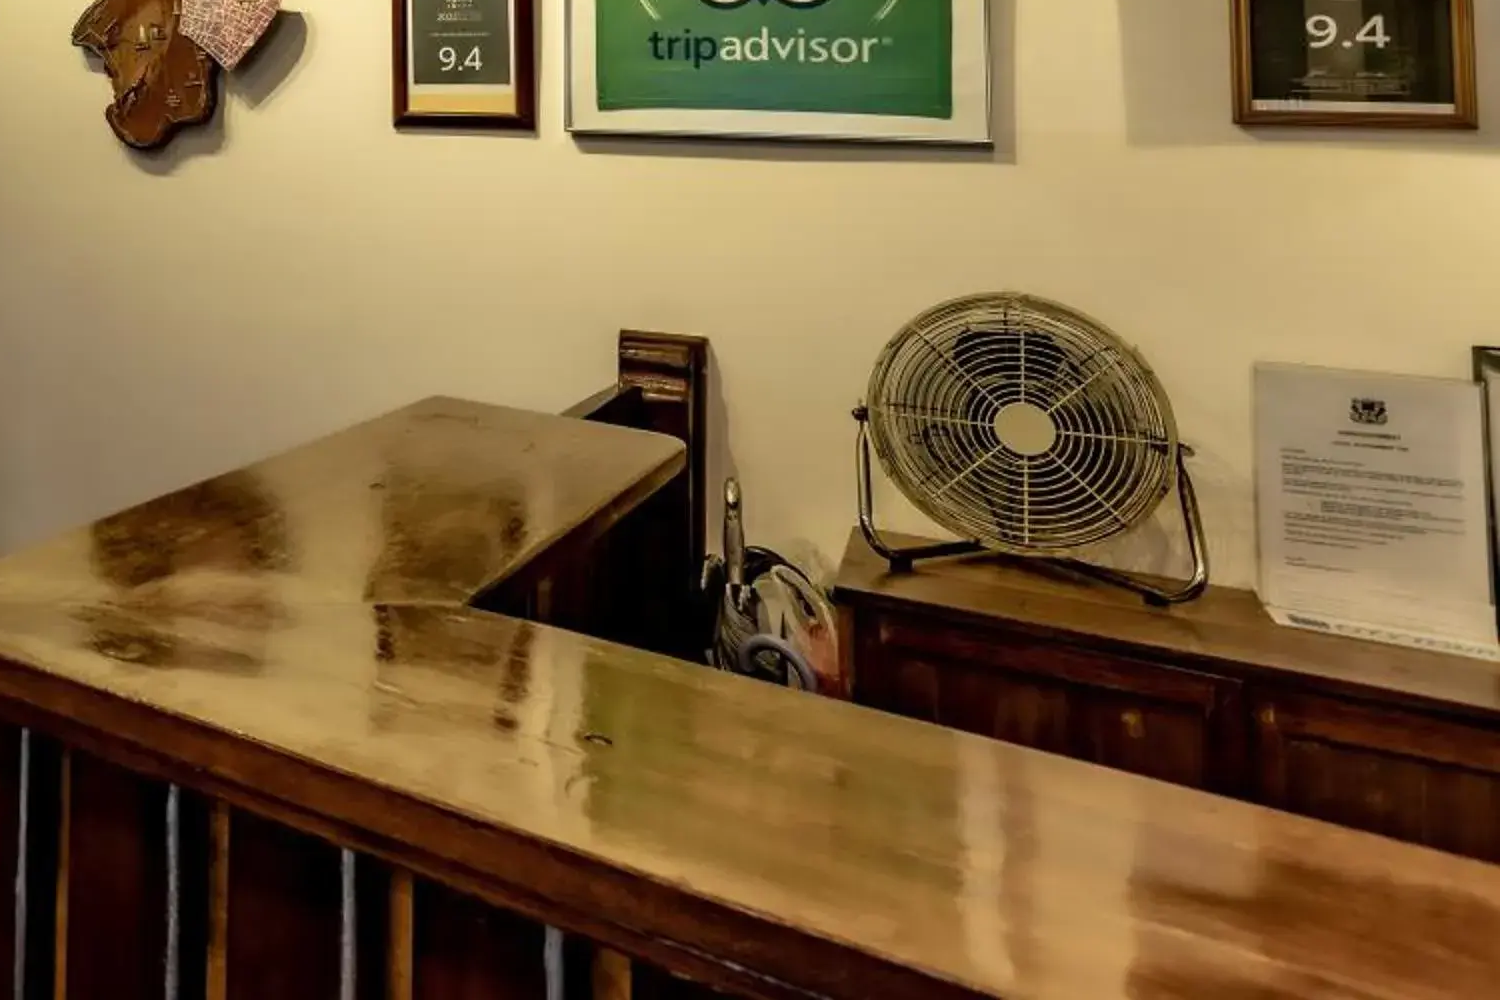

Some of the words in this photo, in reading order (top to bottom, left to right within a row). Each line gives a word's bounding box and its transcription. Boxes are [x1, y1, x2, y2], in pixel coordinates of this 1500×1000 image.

[648, 26, 876, 69] tripadvisor
[1305, 14, 1391, 49] 9.4
[439, 46, 483, 72] 9.4
